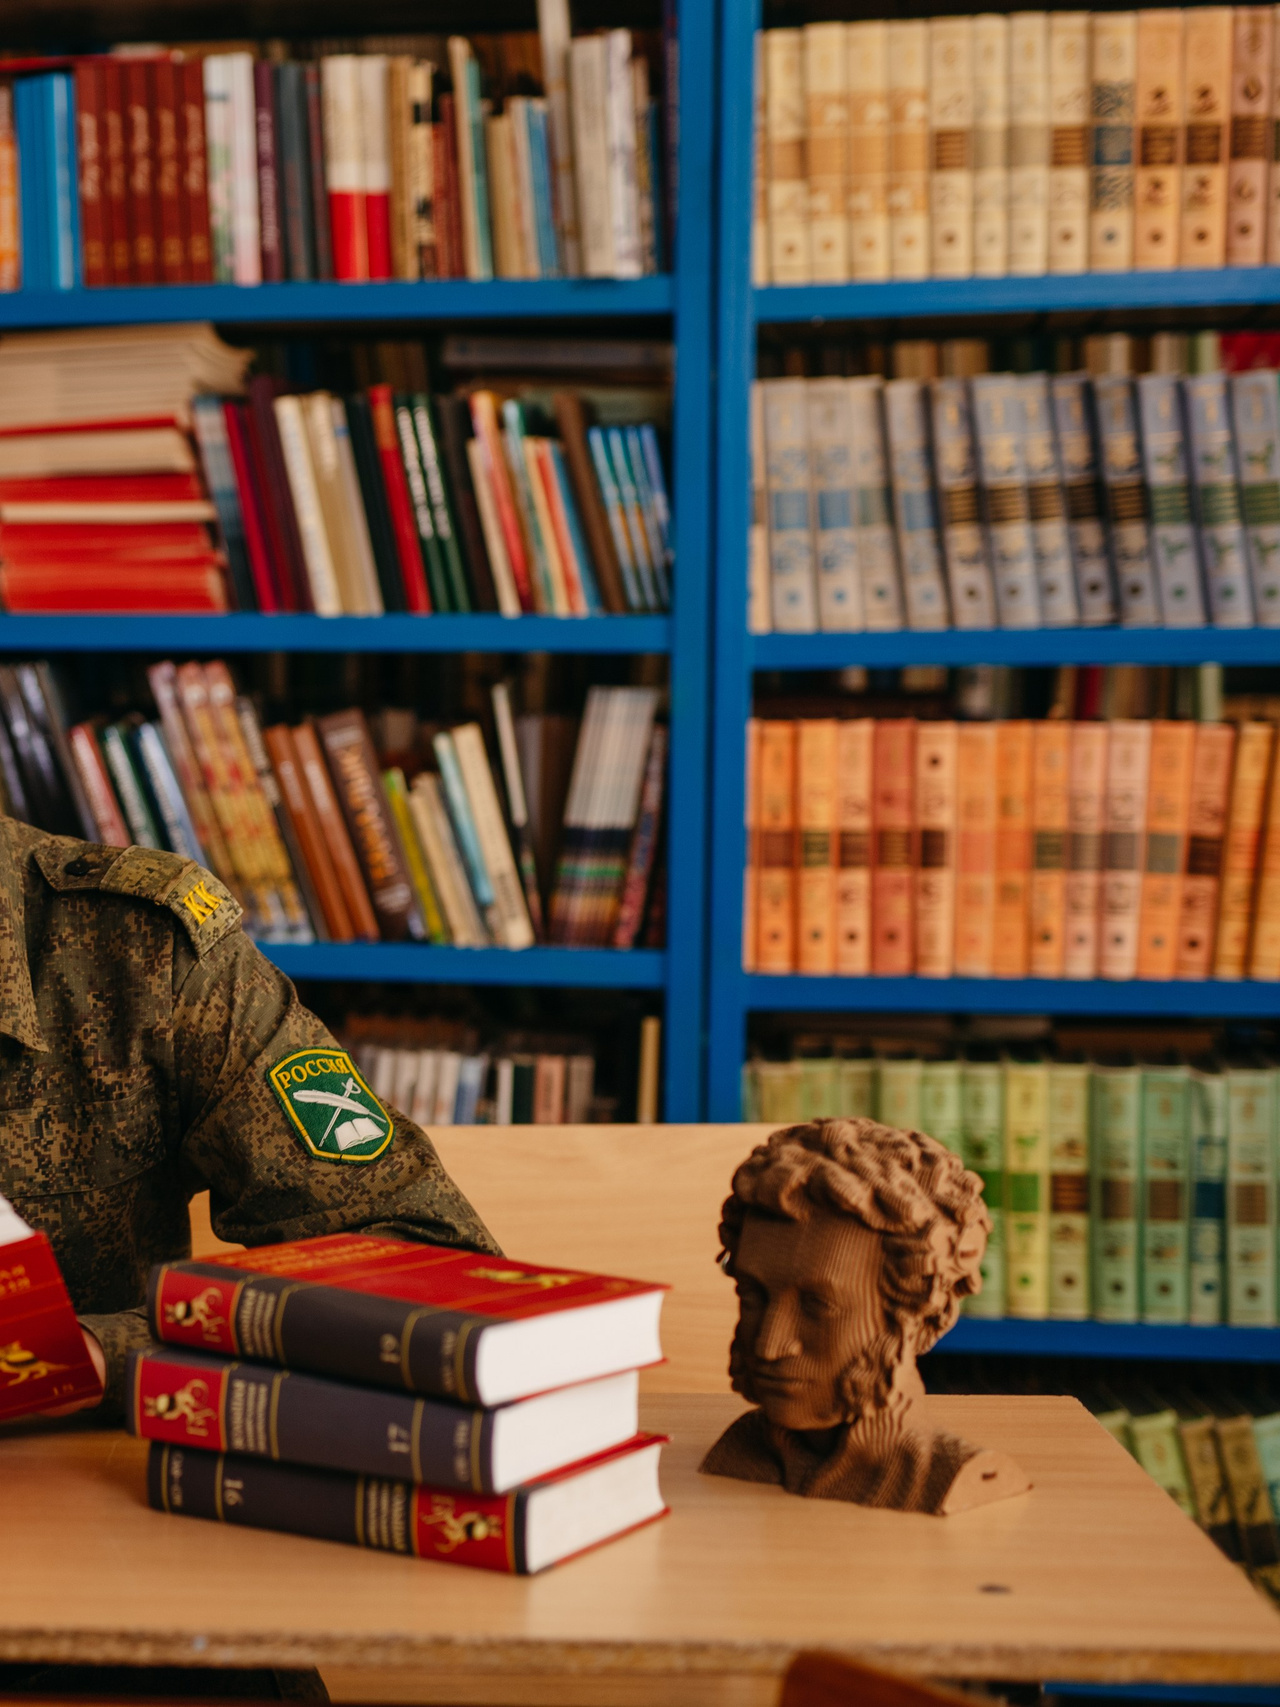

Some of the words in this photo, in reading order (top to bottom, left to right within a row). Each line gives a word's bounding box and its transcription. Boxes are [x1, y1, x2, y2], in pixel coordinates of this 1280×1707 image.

[182, 880, 224, 925] КК
[277, 1057, 351, 1089] РОССИЯ
[380, 1333, 401, 1364] 19
[387, 1422, 411, 1453] 17
[224, 1477, 244, 1507] 16
